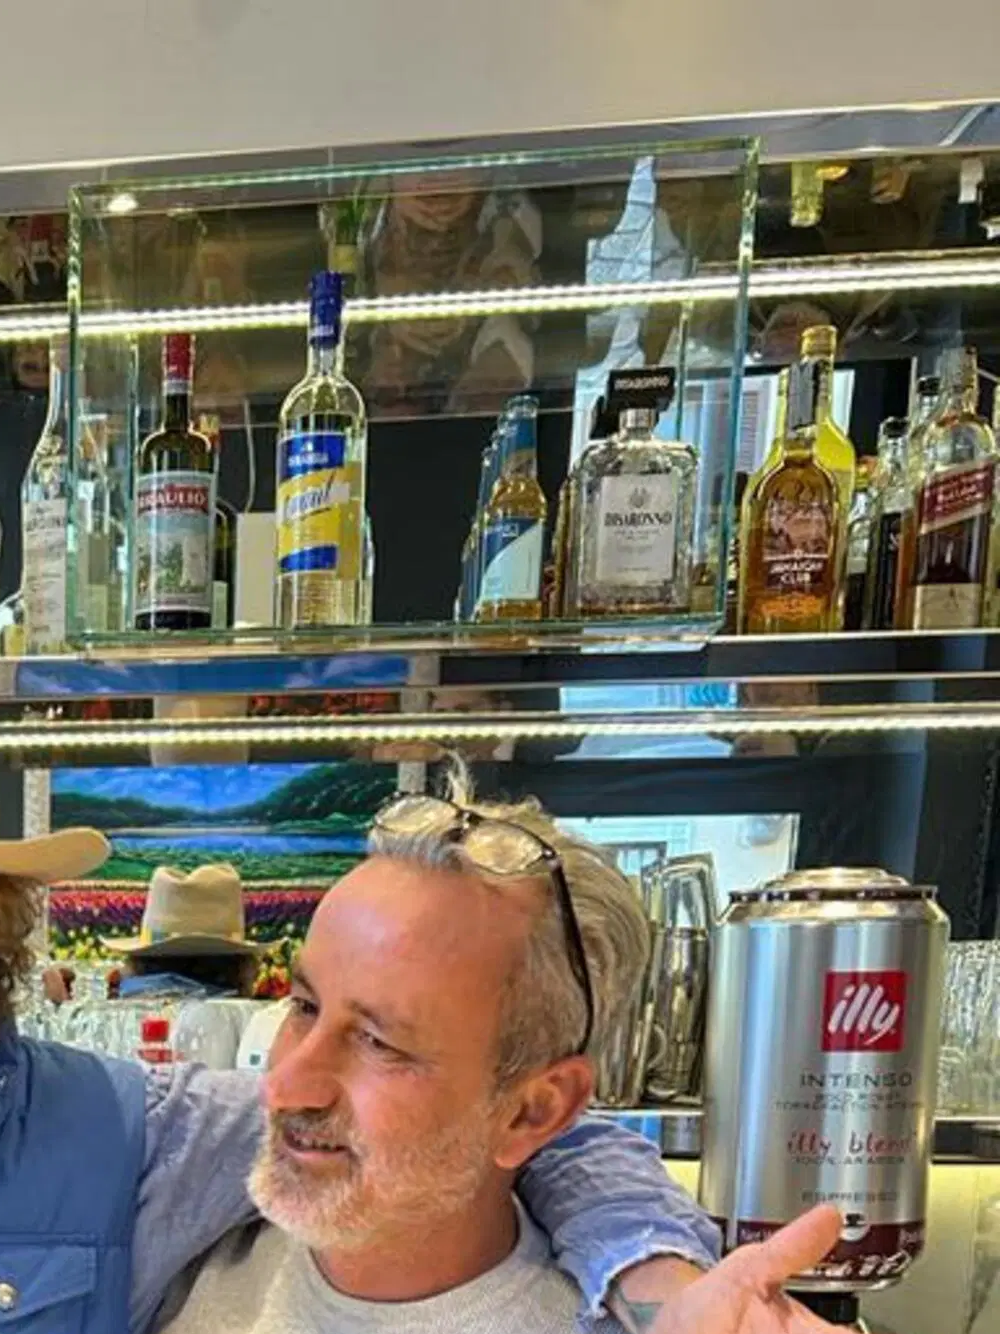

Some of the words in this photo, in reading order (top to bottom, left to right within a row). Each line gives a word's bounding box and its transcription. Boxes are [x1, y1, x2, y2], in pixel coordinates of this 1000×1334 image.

[827, 982, 900, 1046] illy
[801, 1071, 913, 1088] INTENSO
[786, 1130, 832, 1158] illy
